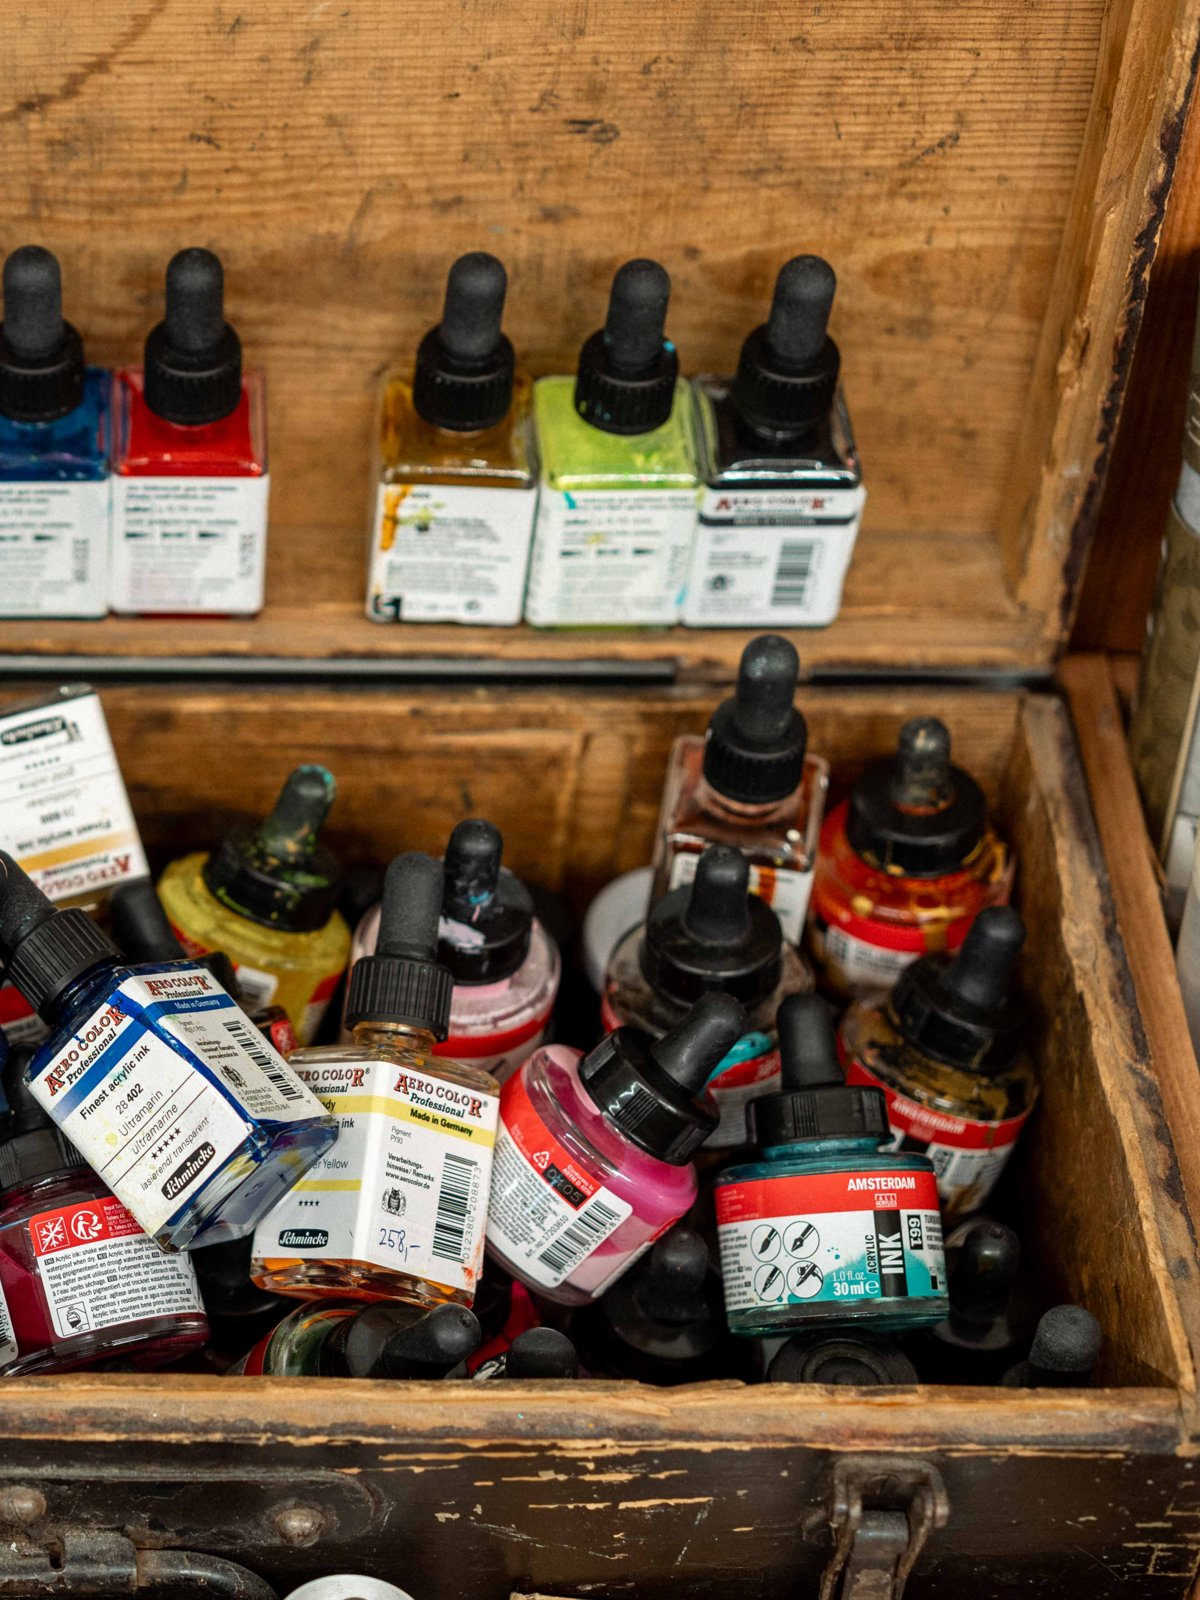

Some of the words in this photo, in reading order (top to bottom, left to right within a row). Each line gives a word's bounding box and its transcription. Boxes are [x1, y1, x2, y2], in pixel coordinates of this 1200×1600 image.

[164, 988, 204, 999] Professional
[44, 1050, 86, 1096] AERO
[77, 1002, 127, 1056] COLOR
[66, 1028, 116, 1084] Professional
[79, 1089, 109, 1120] Finest
[108, 1060, 136, 1091] acrylic
[132, 1044, 150, 1062] ink
[298, 1070, 319, 1082] ERO
[393, 1073, 433, 1101] AERO
[114, 1099, 128, 1115] 28
[126, 1082, 143, 1102] 402
[409, 1092, 465, 1118] Professional
[118, 1090, 163, 1136] Ultramarin
[341, 1118, 354, 1128] ink
[409, 1108, 430, 1122] Made
[431, 1115, 439, 1125] in
[439, 1117, 473, 1136] Germany
[132, 1104, 177, 1154] ultramarine
[140, 1154, 172, 1190] lasierend/
[172, 1116, 209, 1157] transparent
[322, 1157, 348, 1169] Yellow
[164, 1143, 214, 1199] Schmincke
[848, 1177, 916, 1191] AMSTERDAM
[82, 1247, 97, 1255] shake
[108, 1241, 123, 1249] before
[279, 1229, 327, 1246] Schmincke
[865, 1234, 879, 1274] ACRYLIC
[878, 1232, 904, 1274] INK
[832, 1271, 846, 1281] 1.0
[833, 1282, 849, 1296] 30
[850, 1282, 864, 1295] ml
